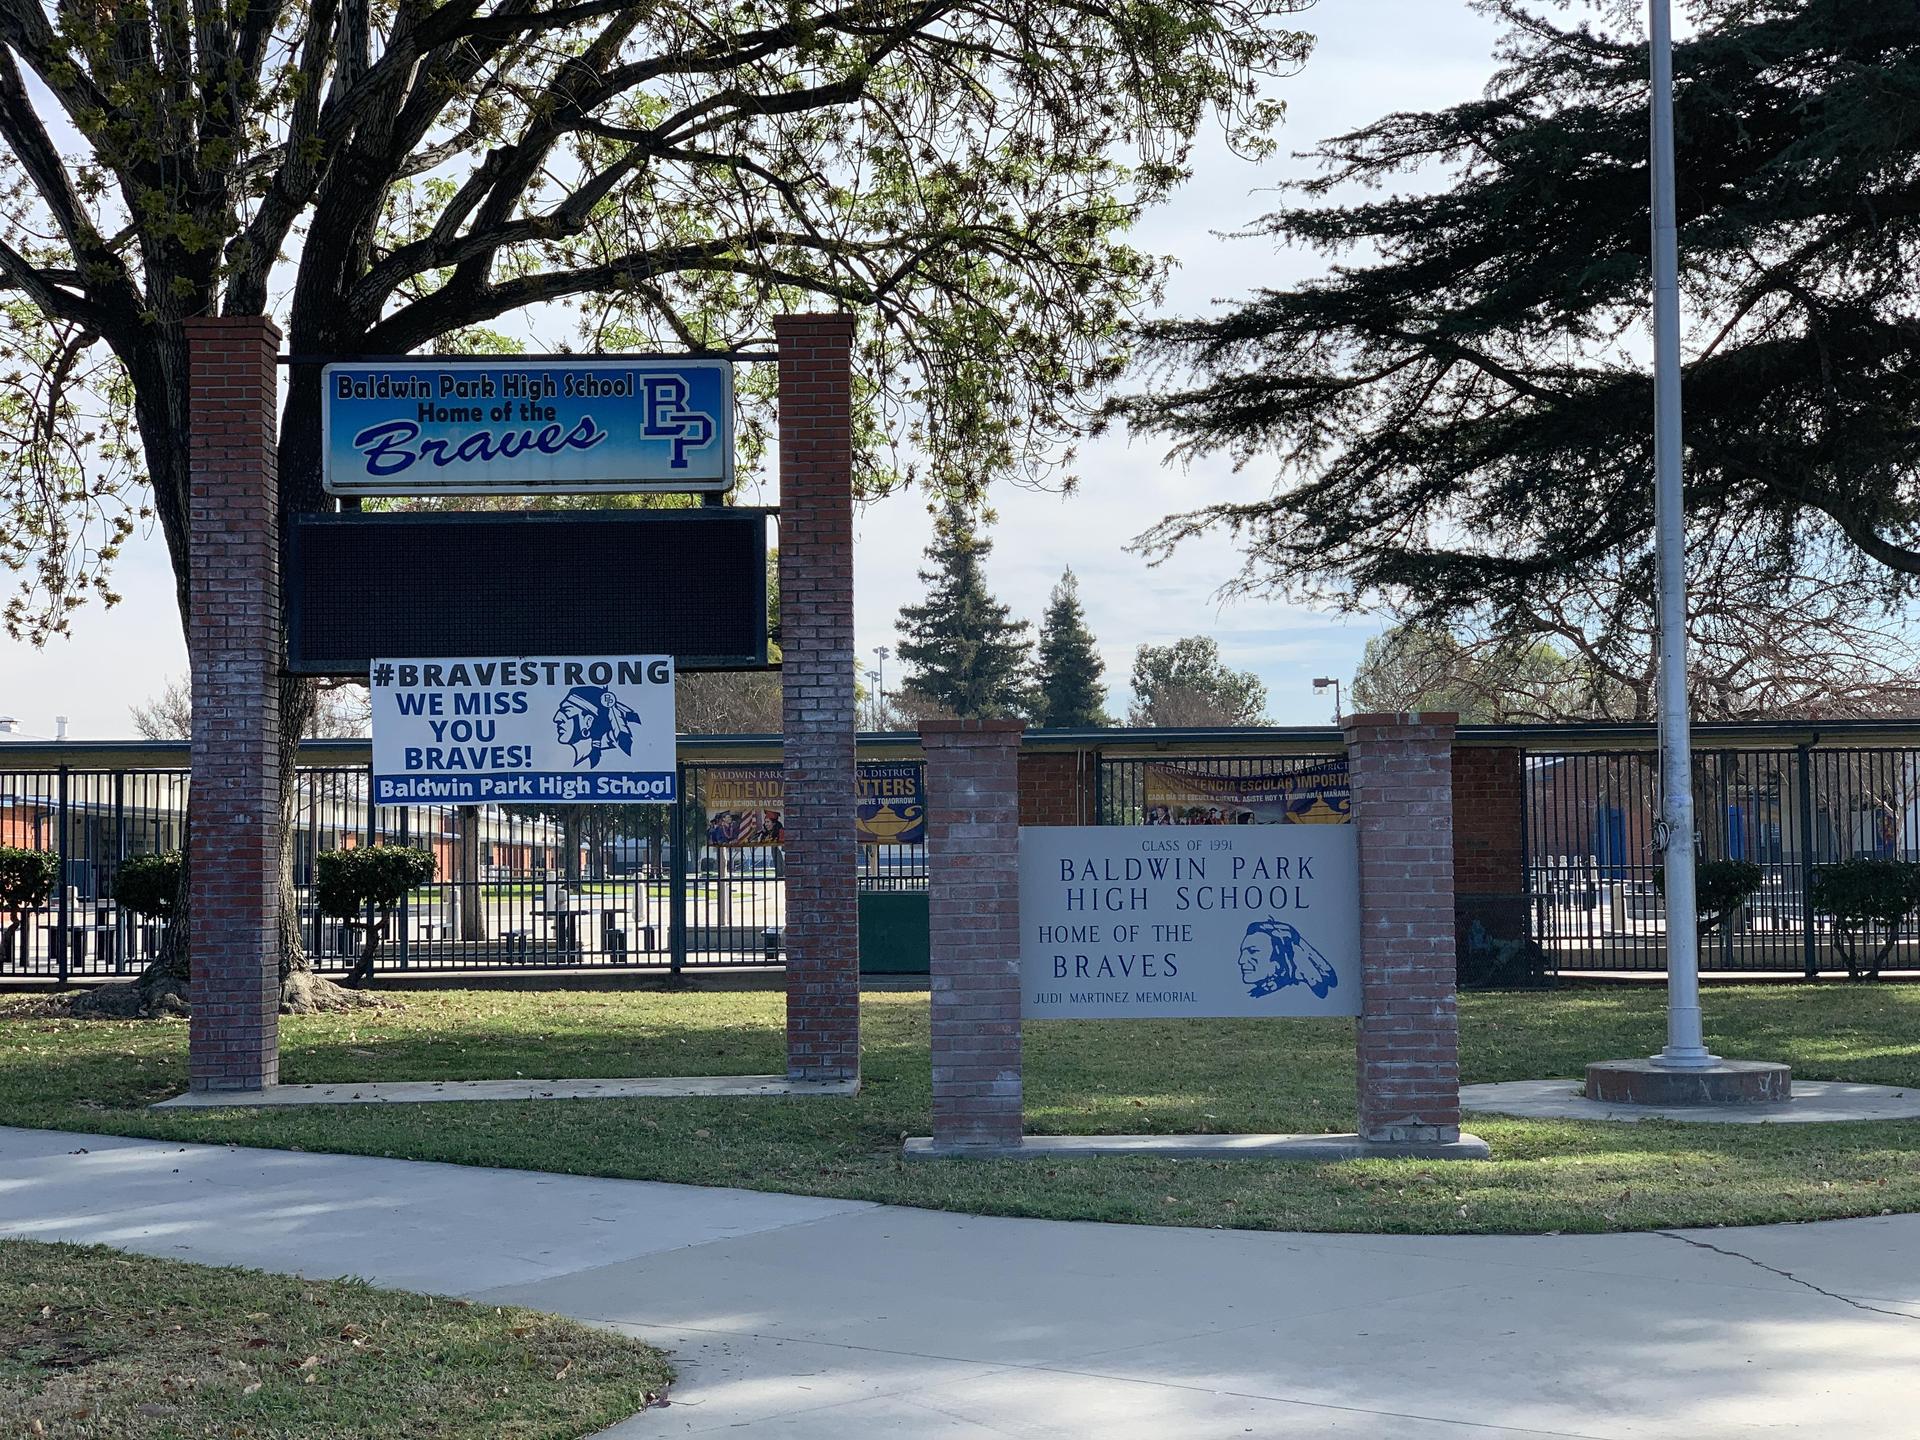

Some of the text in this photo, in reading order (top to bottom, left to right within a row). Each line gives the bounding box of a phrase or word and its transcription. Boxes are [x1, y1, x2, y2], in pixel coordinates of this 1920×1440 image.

[337, 375, 431, 399] Baldwin
[440, 374, 496, 399] Park
[502, 374, 556, 401] High
[564, 372, 633, 398] School
[417, 402, 556, 423] Home of the
[353, 414, 608, 477] Braves
[373, 660, 670, 687] #BRAVESTRONG
[396, 691, 528, 716] WE MISS
[428, 719, 496, 743] YOU
[405, 745, 532, 770] BRAVES!
[711, 770, 783, 780] BALDWIN PARK
[872, 768, 915, 777] DISTRICT
[1240, 776, 1293, 791] ESCOLAR
[380, 775, 671, 799] Baldwin Park High School
[733, 799, 758, 807] SCHOOL
[1142, 840, 1232, 851] CLASS OF 1991
[1060, 856, 1315, 882] BALDWIN PARK
[1066, 886, 1310, 911] HIGH SCHOOL
[1039, 924, 1193, 943] HOME OF THE
[1053, 953, 1178, 978] BRAVES
[1033, 991, 1198, 1004] JUDI MARTINEZ MEMORIAL
